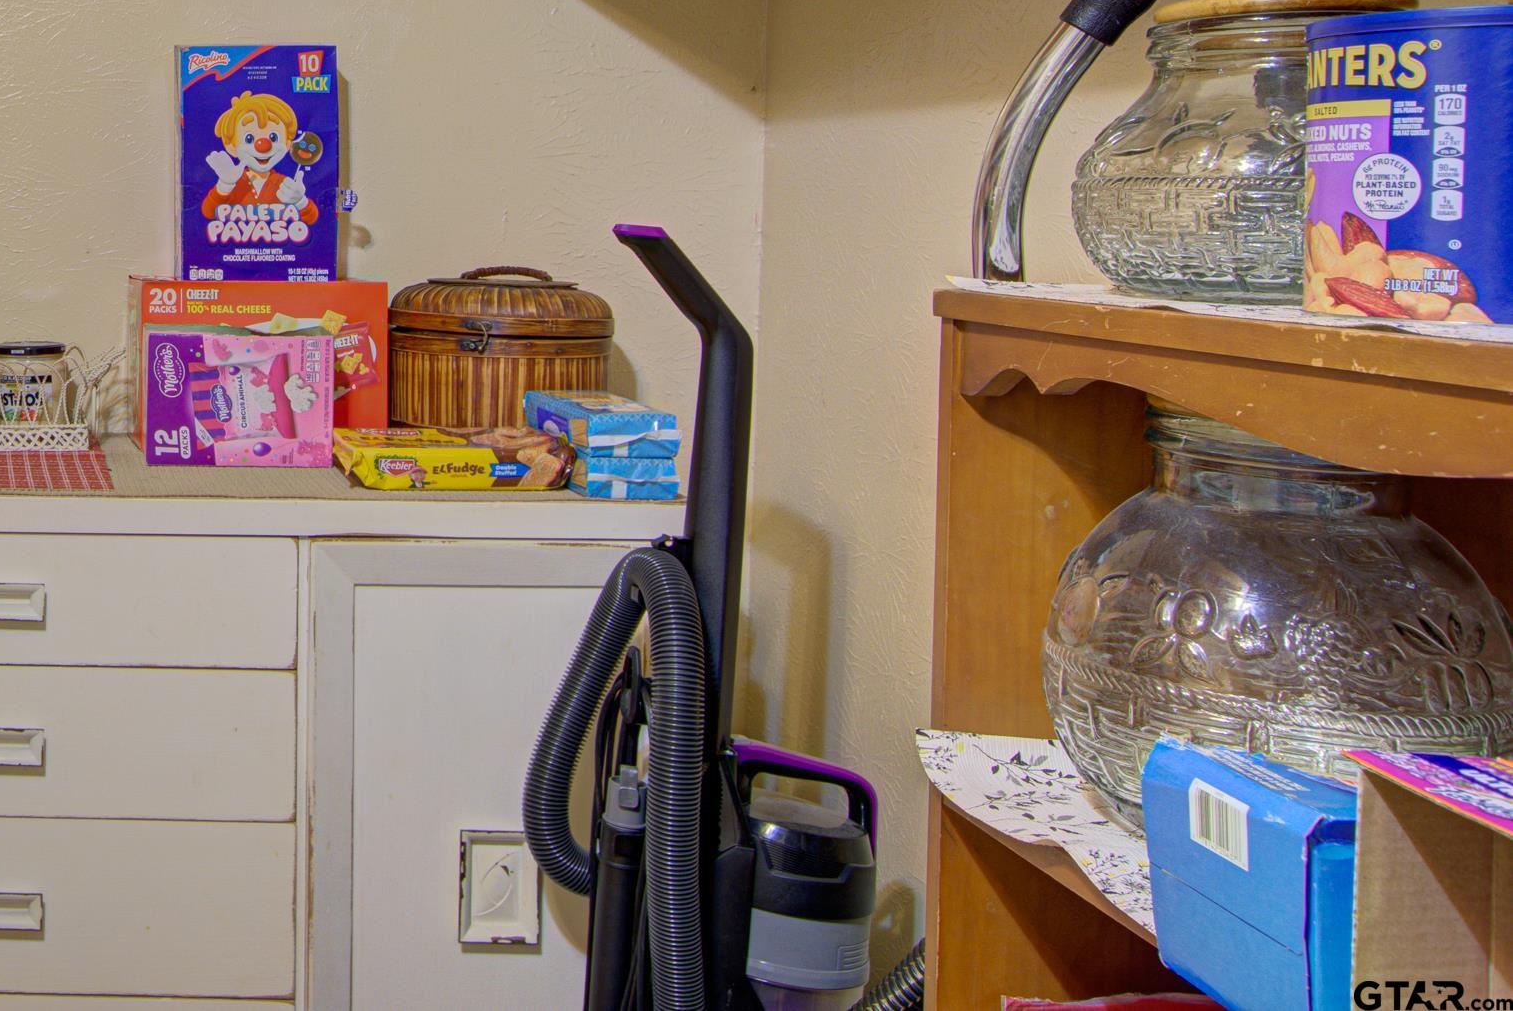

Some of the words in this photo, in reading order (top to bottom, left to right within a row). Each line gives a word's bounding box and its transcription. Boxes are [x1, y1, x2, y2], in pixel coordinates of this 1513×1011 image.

[188, 51, 229, 68] Ricolino
[299, 54, 320, 73] 10
[295, 76, 329, 92] PACK
[1314, 106, 1338, 117] SALTED
[1438, 97, 1463, 110] 170
[1328, 123, 1372, 141] NUTS
[1372, 157, 1409, 173] PROTEIN
[1355, 181, 1417, 189] PLANT-BASED
[1365, 189, 1404, 198] PROTEIN
[217, 203, 300, 222] PALETA
[207, 219, 309, 243] PAYASO
[1424, 268, 1441, 280] NET
[1441, 268, 1460, 280] WT
[1384, 278, 1390, 290] 3
[1391, 279, 1401, 290] LB
[1410, 280, 1422, 292] OZ
[149, 287, 177, 306] 20
[149, 305, 177, 314] PACKS
[186, 305, 209, 314] 100%
[210, 305, 234, 314] REAL
[236, 305, 271, 315] CHEESE
[236, 374, 246, 400] ANIMAL
[239, 400, 248, 429] CIRCUS
[153, 429, 180, 457] 12
[181, 429, 189, 456] PACKS
[379, 458, 414, 472] Keebler
